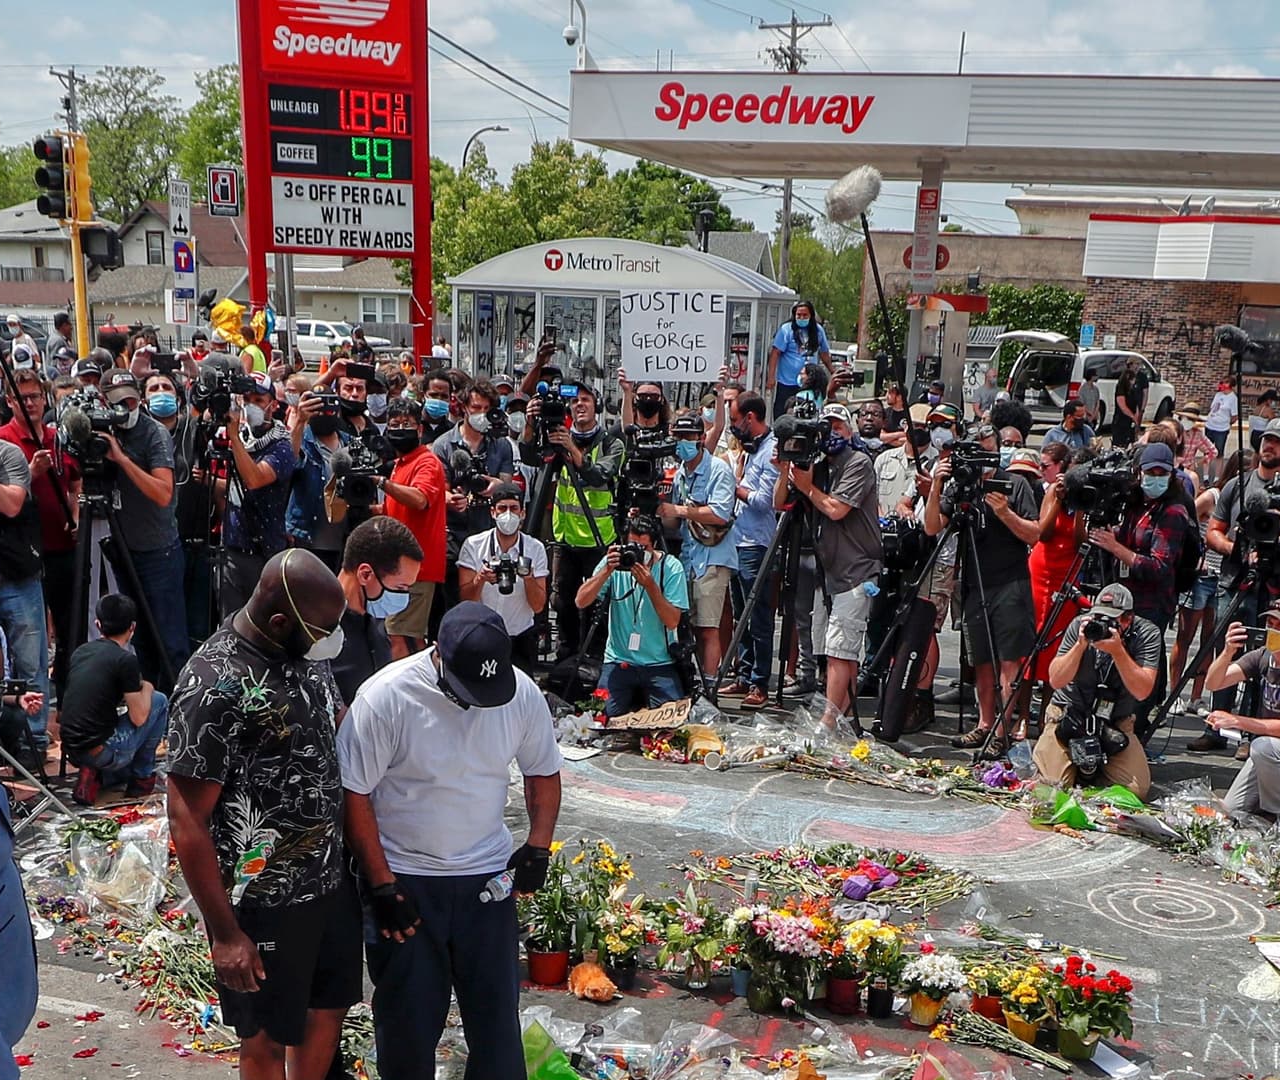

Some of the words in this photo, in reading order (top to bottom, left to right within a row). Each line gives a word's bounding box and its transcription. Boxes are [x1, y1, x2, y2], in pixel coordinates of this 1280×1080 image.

[273, 25, 402, 66] Speedway
[270, 98, 319, 115] UNLEADED
[655, 82, 874, 133] Speedway
[279, 146, 316, 161] COFFEE
[171, 183, 188, 194] TRUCK
[309, 184, 337, 201] OFF
[341, 186, 370, 204] PER
[373, 188, 407, 206] GAL
[171, 197, 188, 208] ROUTE
[321, 206, 362, 225] WITH
[275, 226, 335, 246] SPEEDY
[340, 230, 414, 249] REWARDS
[622, 291, 725, 314] JUSTICE
[656, 317, 675, 330] for
[631, 331, 707, 351] GEORGE
[644, 355, 707, 373] FLOYD
